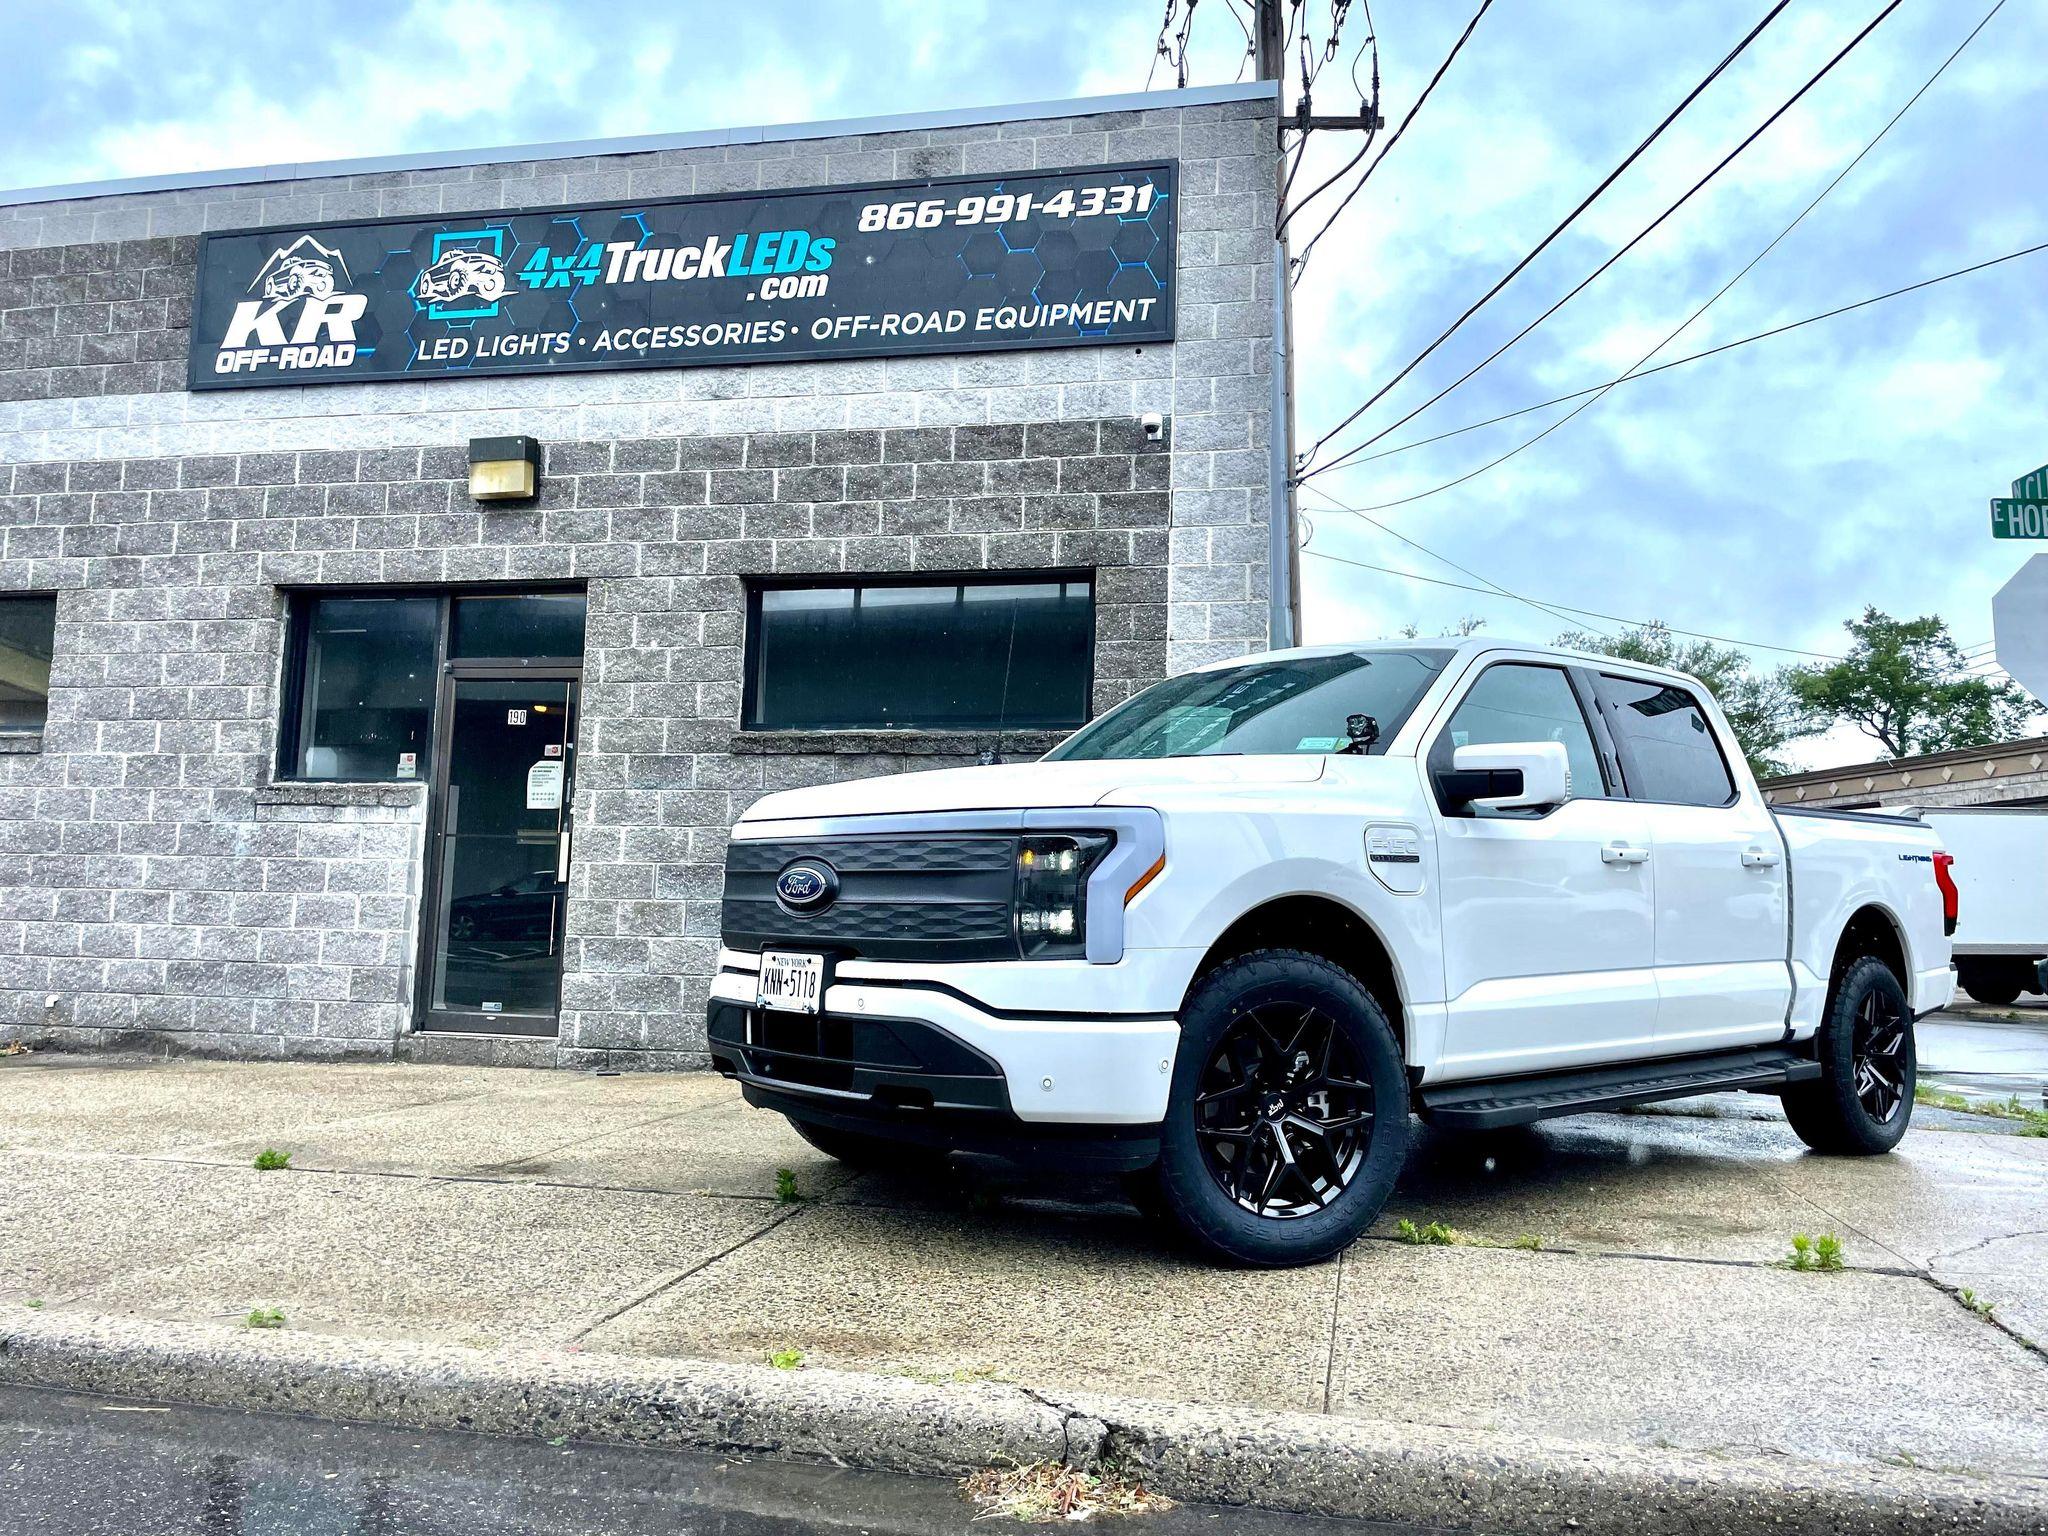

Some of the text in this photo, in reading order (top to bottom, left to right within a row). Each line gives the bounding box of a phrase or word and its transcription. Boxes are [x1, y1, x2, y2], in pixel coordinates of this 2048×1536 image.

[858, 184, 1156, 234] 866-991-4331
[746, 274, 831, 303] .com
[220, 293, 368, 349] KR
[417, 297, 1157, 362] LED LIGHTS ACCESSORIES OFF-ROAD EQUIPMENT
[214, 343, 358, 374] OFF-ROAD
[2013, 481, 2022, 499] N
[1993, 500, 2005, 522] E
[509, 710, 526, 724] 190
[785, 875, 811, 894] Ford
[777, 957, 807, 968] NEW YORK
[789, 969, 816, 999] 5118
